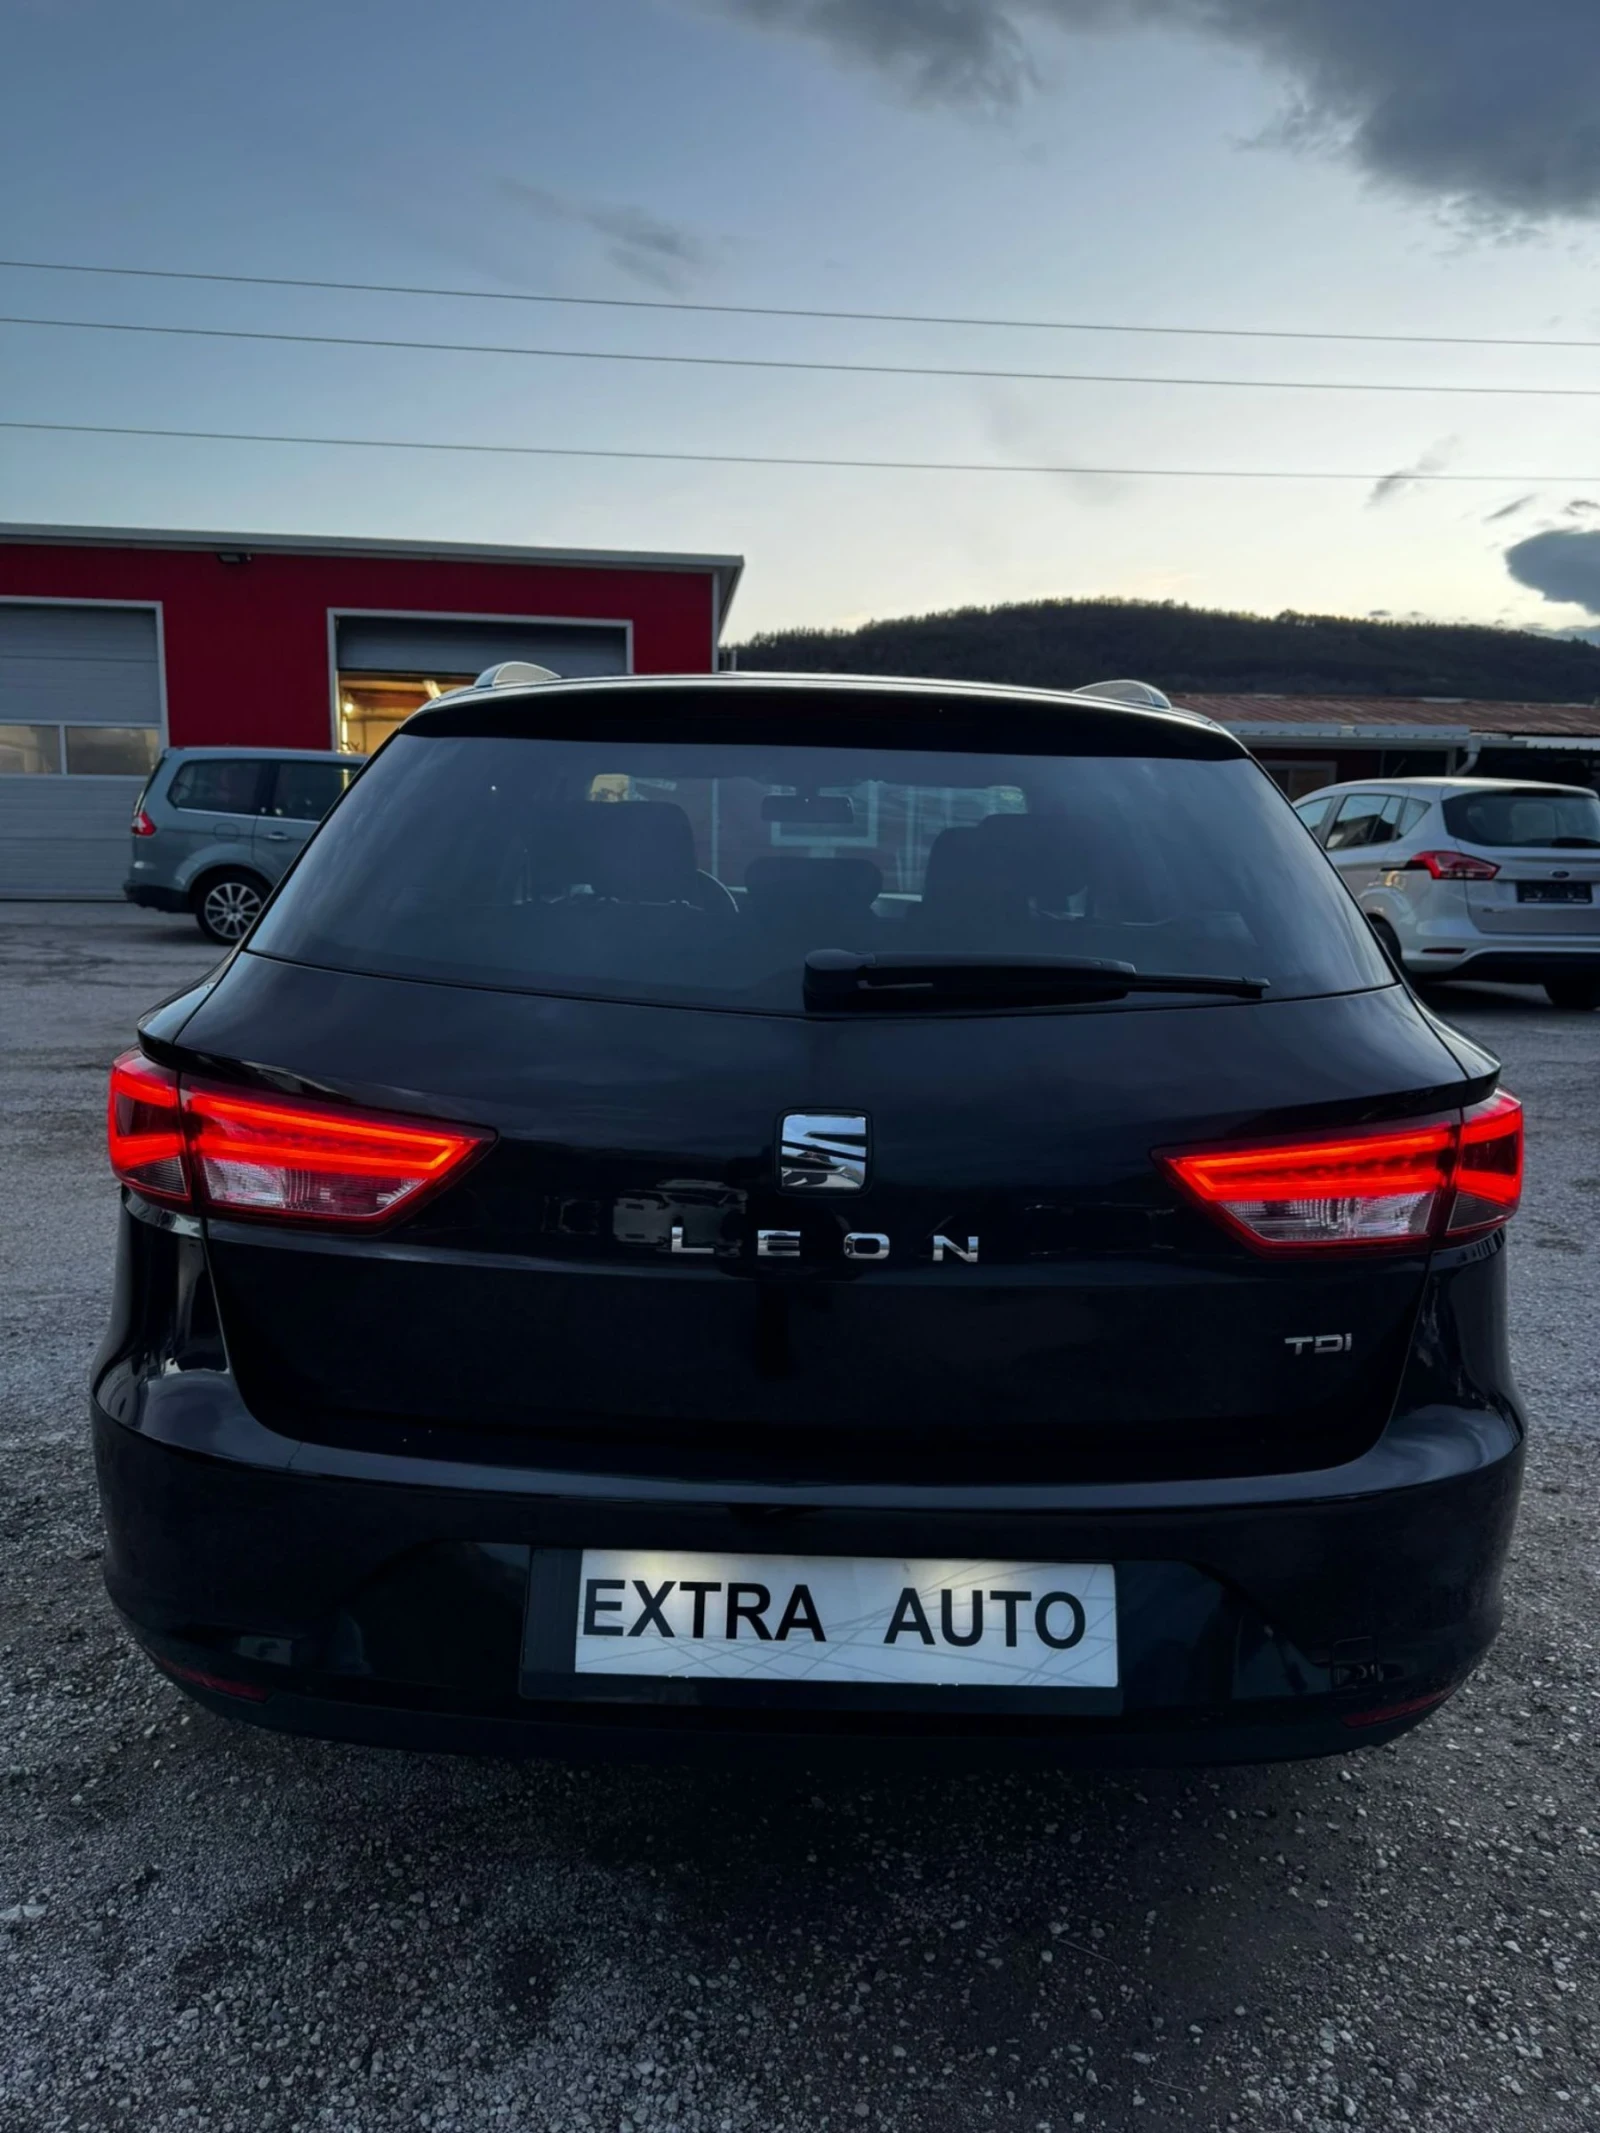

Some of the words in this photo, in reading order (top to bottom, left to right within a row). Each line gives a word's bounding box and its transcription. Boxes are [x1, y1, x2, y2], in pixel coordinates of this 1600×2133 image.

[671, 1226, 980, 1263] LEON
[1284, 1332, 1353, 1355] TDI
[582, 1578, 826, 1643] EXTRA
[883, 1587, 1087, 1649] AUTO
